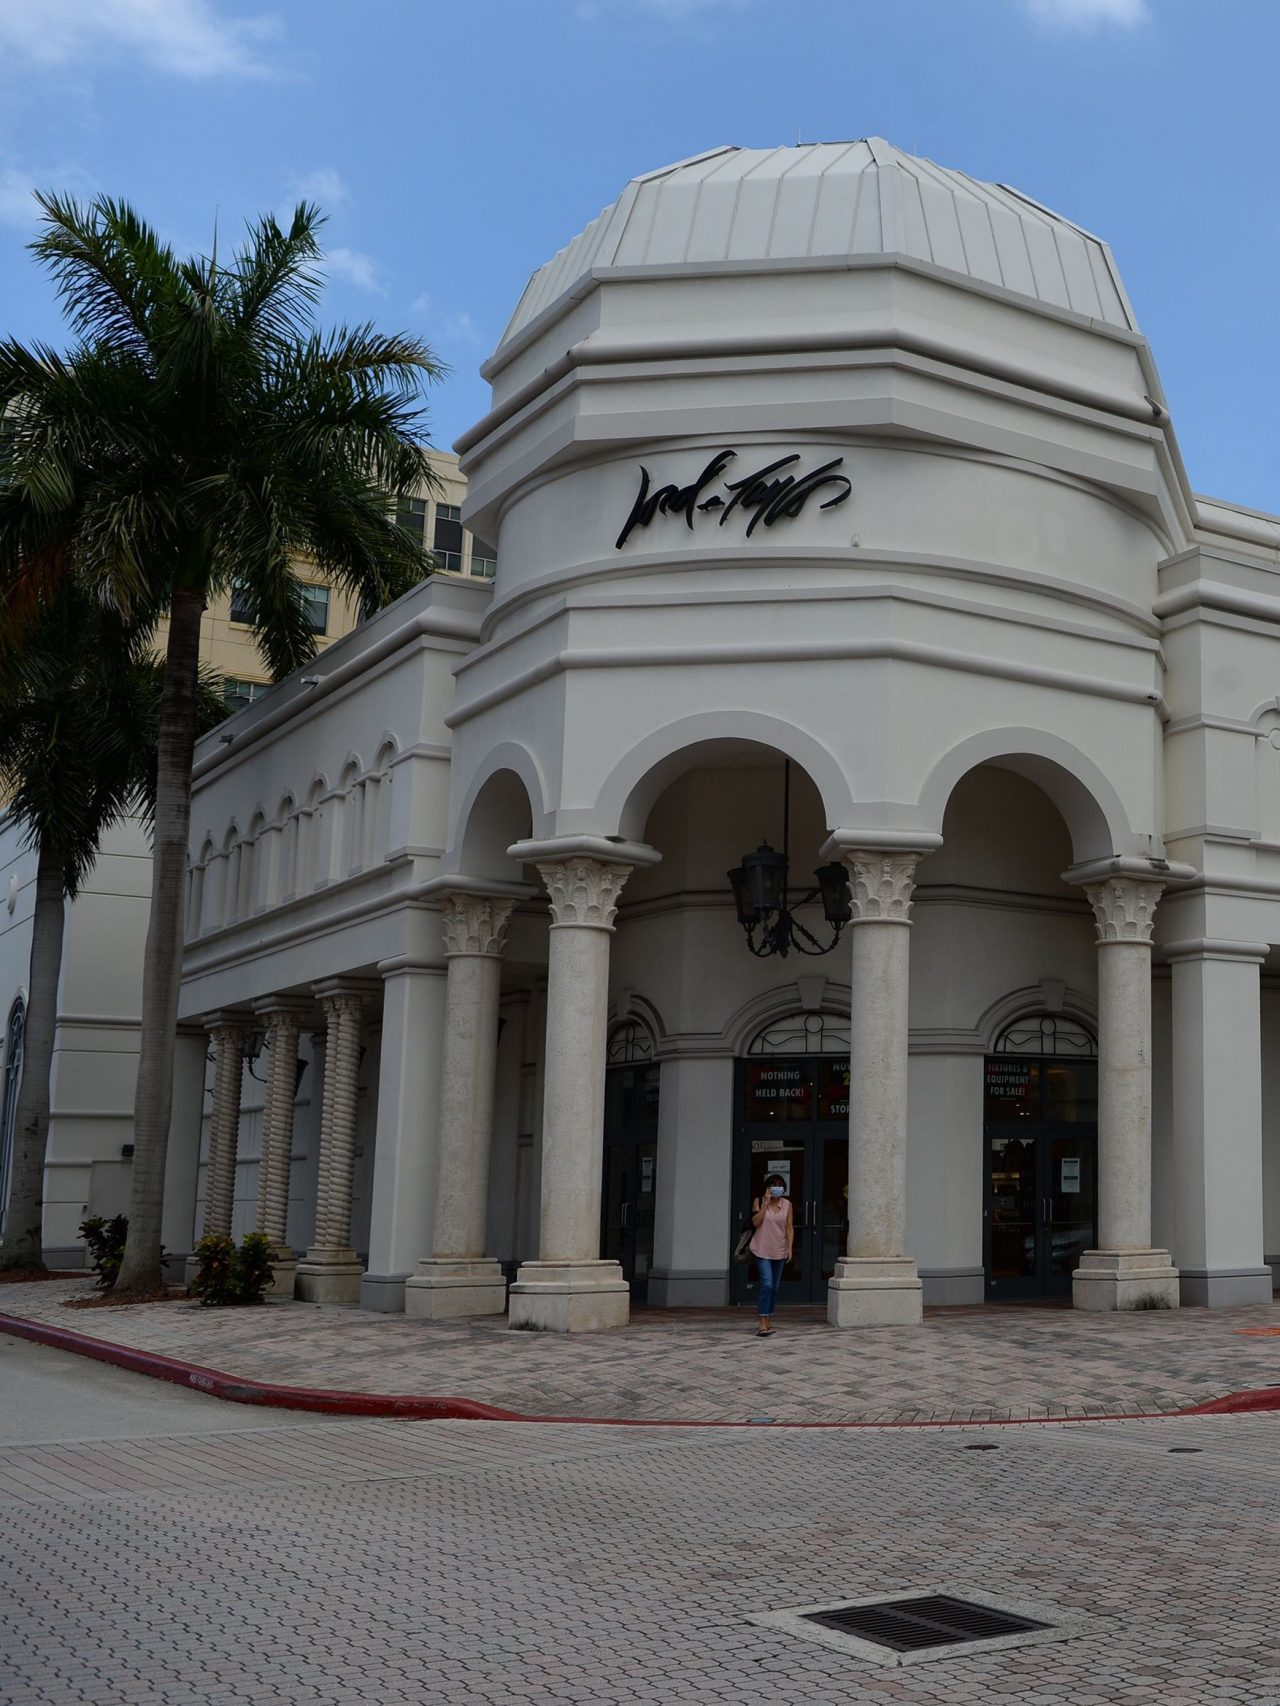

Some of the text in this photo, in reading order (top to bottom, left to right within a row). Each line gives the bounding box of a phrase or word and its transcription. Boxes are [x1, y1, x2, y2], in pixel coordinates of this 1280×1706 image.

[988, 1063, 1020, 1072] FIXTURES
[760, 1071, 801, 1080] NOTHING
[987, 1075, 1029, 1084] EQUIPMENT
[755, 1087, 805, 1097] HELD BACK!
[990, 1086, 1025, 1096] FOR SALE!
